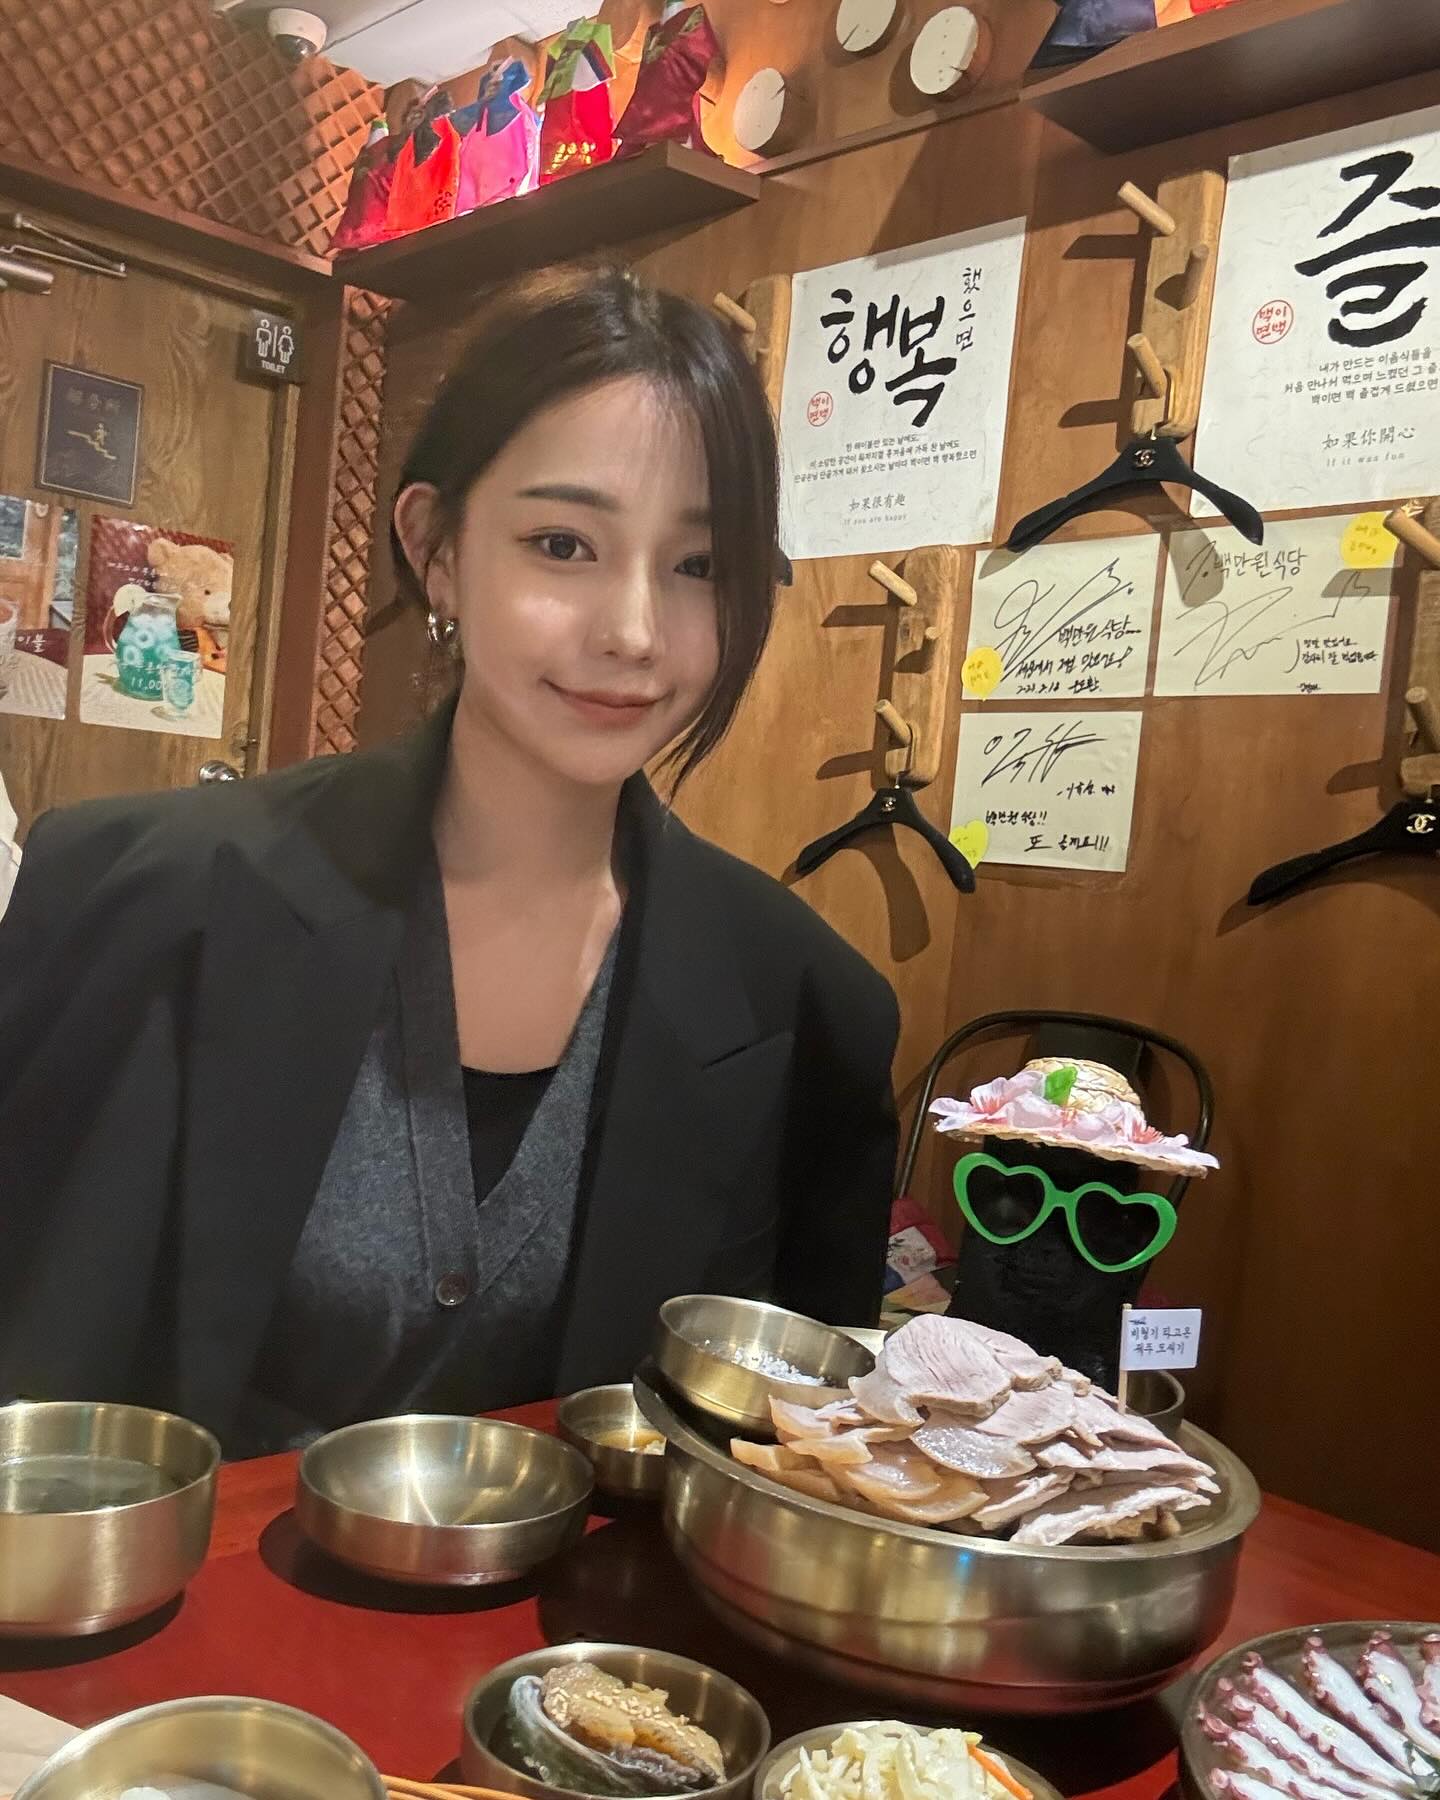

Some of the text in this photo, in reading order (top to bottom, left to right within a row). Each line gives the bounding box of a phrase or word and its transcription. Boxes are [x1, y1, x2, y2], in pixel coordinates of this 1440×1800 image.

[956, 267, 982, 351] 했으면
[260, 359, 286, 374] TOILET
[819, 286, 959, 429] 행복
[1318, 360, 1340, 373] 내가
[1343, 357, 1375, 371] 만드는
[1307, 376, 1339, 391] 만나서
[1342, 371, 1374, 385] 먹으며
[1321, 425, 1416, 450] 如果你開心
